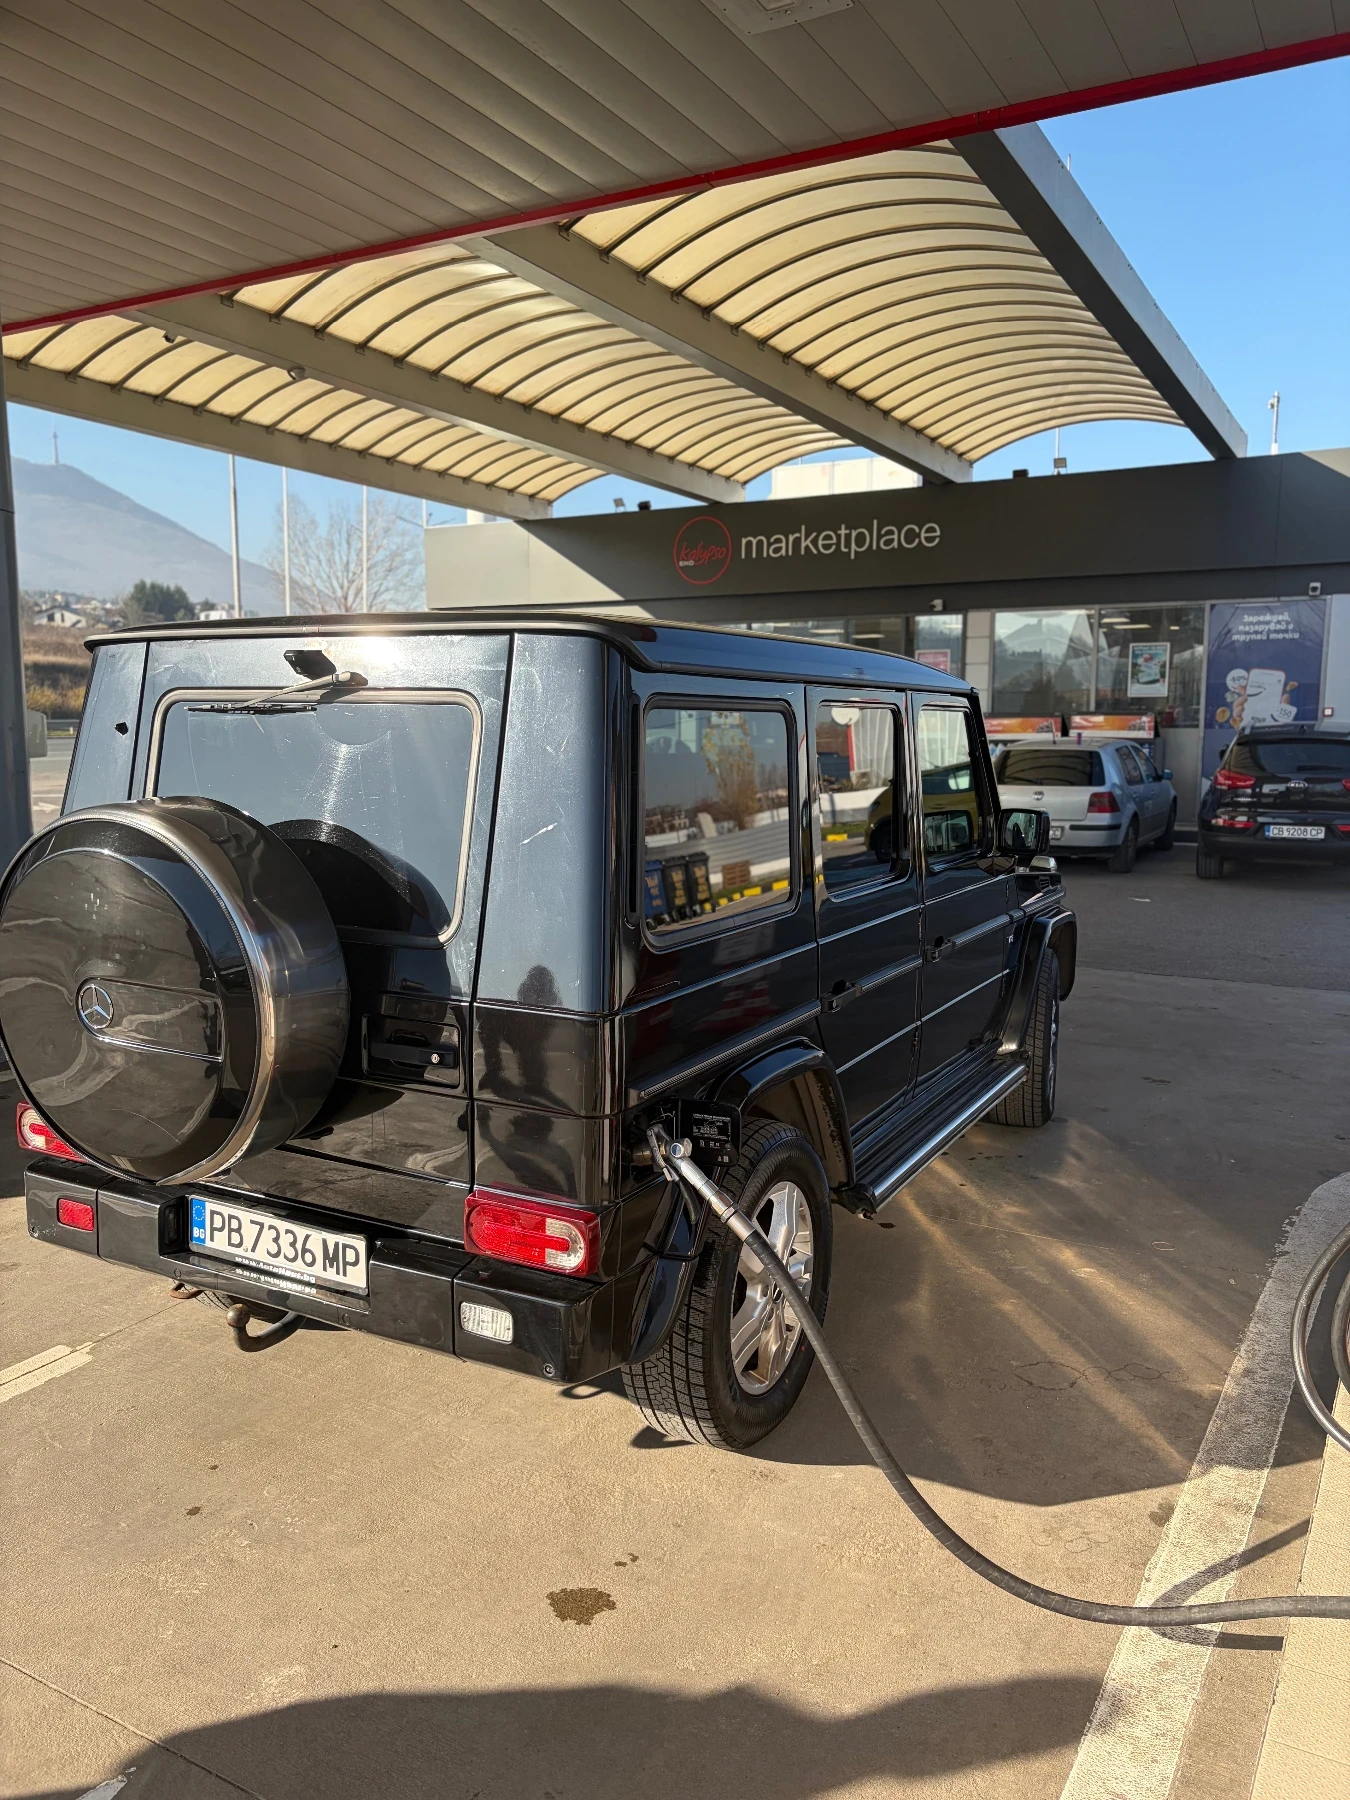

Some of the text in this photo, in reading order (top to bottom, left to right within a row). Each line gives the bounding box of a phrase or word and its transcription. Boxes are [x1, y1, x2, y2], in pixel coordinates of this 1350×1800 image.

[741, 519, 941, 560] marketplace
[1242, 612, 1291, 623] Зареждай,
[1238, 622, 1286, 633] пазарувай
[1232, 631, 1300, 642] трупай точки
[1271, 827, 1285, 836] CB
[1287, 827, 1308, 837] 9208
[1310, 828, 1323, 837] CP
[193, 1226, 205, 1239] BG
[209, 1209, 360, 1277] PB 7336 MP
